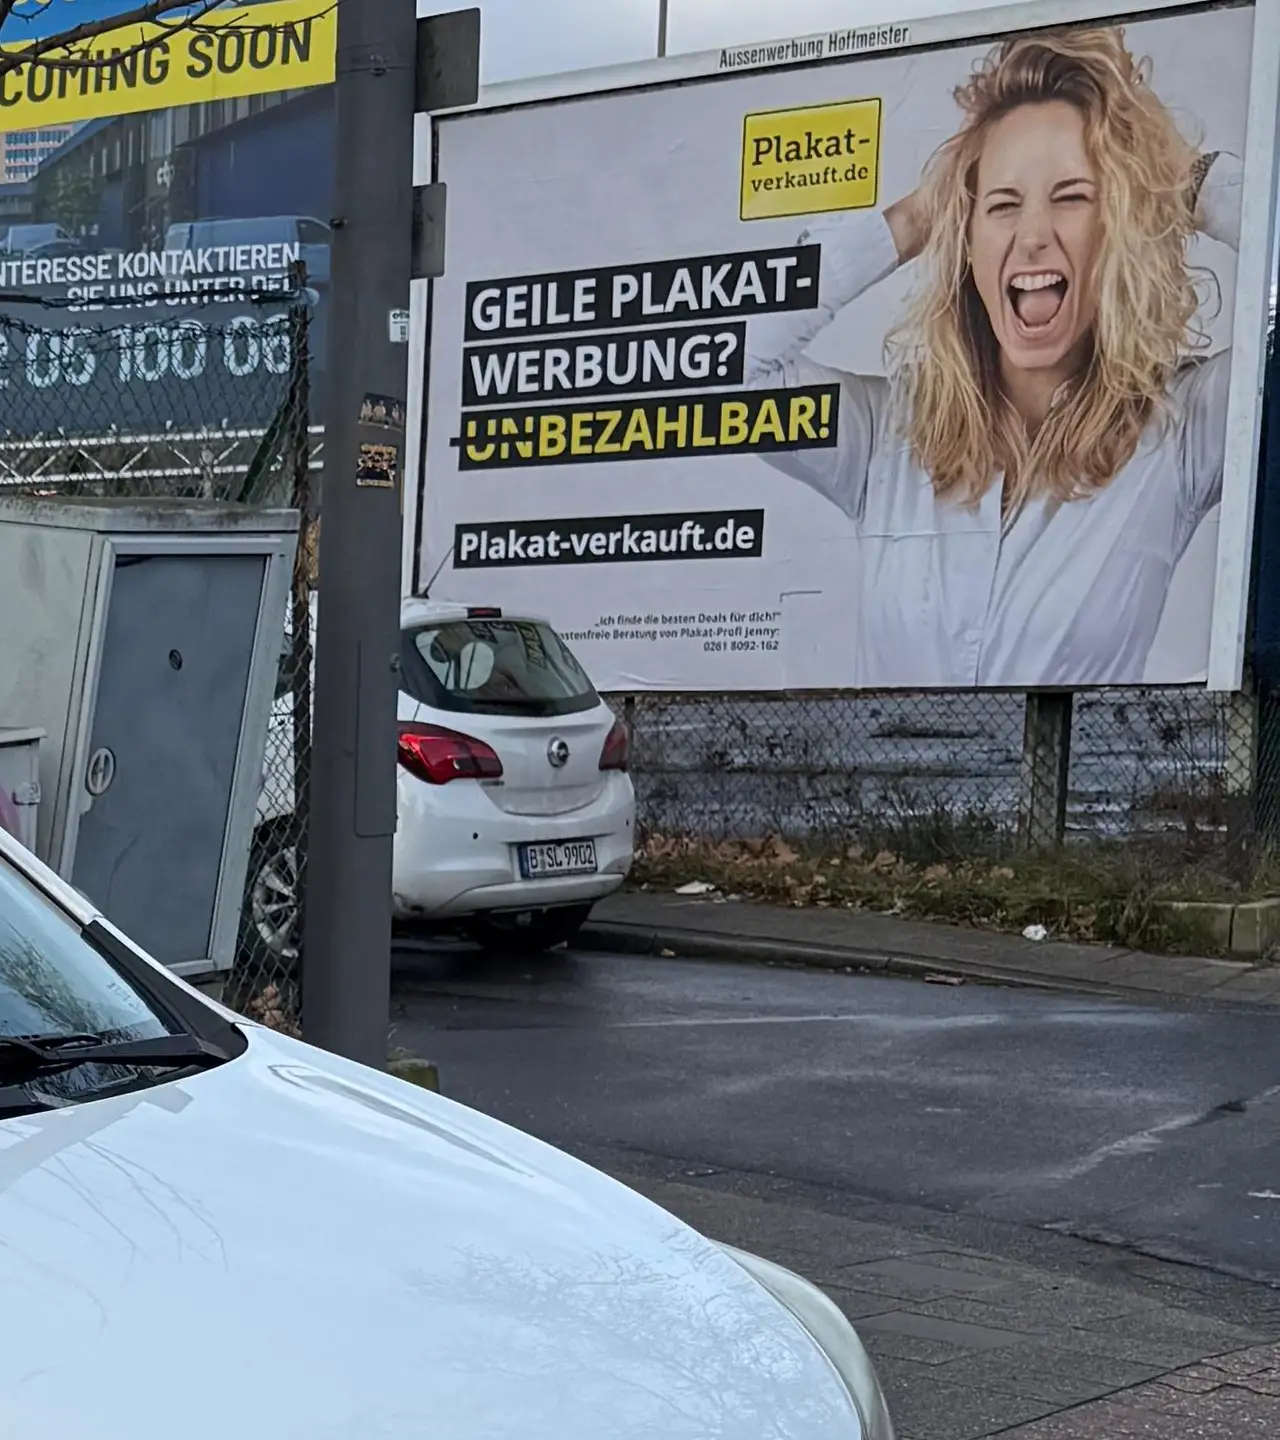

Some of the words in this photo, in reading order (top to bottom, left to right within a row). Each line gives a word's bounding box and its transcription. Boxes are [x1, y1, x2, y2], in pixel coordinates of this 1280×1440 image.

[186, 20, 313, 79] SOON
[719, 38, 824, 69] Aussenwerbung
[828, 25, 910, 53] Hoffmeister
[751, 128, 871, 166] Plakat-
[751, 164, 869, 192] verkauft.de
[117, 240, 300, 281] KONTAKTIEREN
[67, 285, 104, 312] SIE
[109, 281, 159, 309] UNS
[164, 276, 246, 306] UNTER
[471, 278, 597, 331] GEILE
[611, 256, 813, 319] PLAKAT-
[469, 332, 739, 397] WERBUNG?
[466, 394, 833, 462] UNBEZAHLBAR!
[459, 519, 756, 562] Plakat-verkauft.de
[613, 629, 657, 641] Beratung
[659, 630, 678, 638] von
[617, 614, 642, 625] finde
[644, 613, 659, 624] die
[661, 613, 696, 625] besten
[698, 612, 727, 624] Deals
[729, 612, 747, 622] für
[529, 848, 539, 869] B
